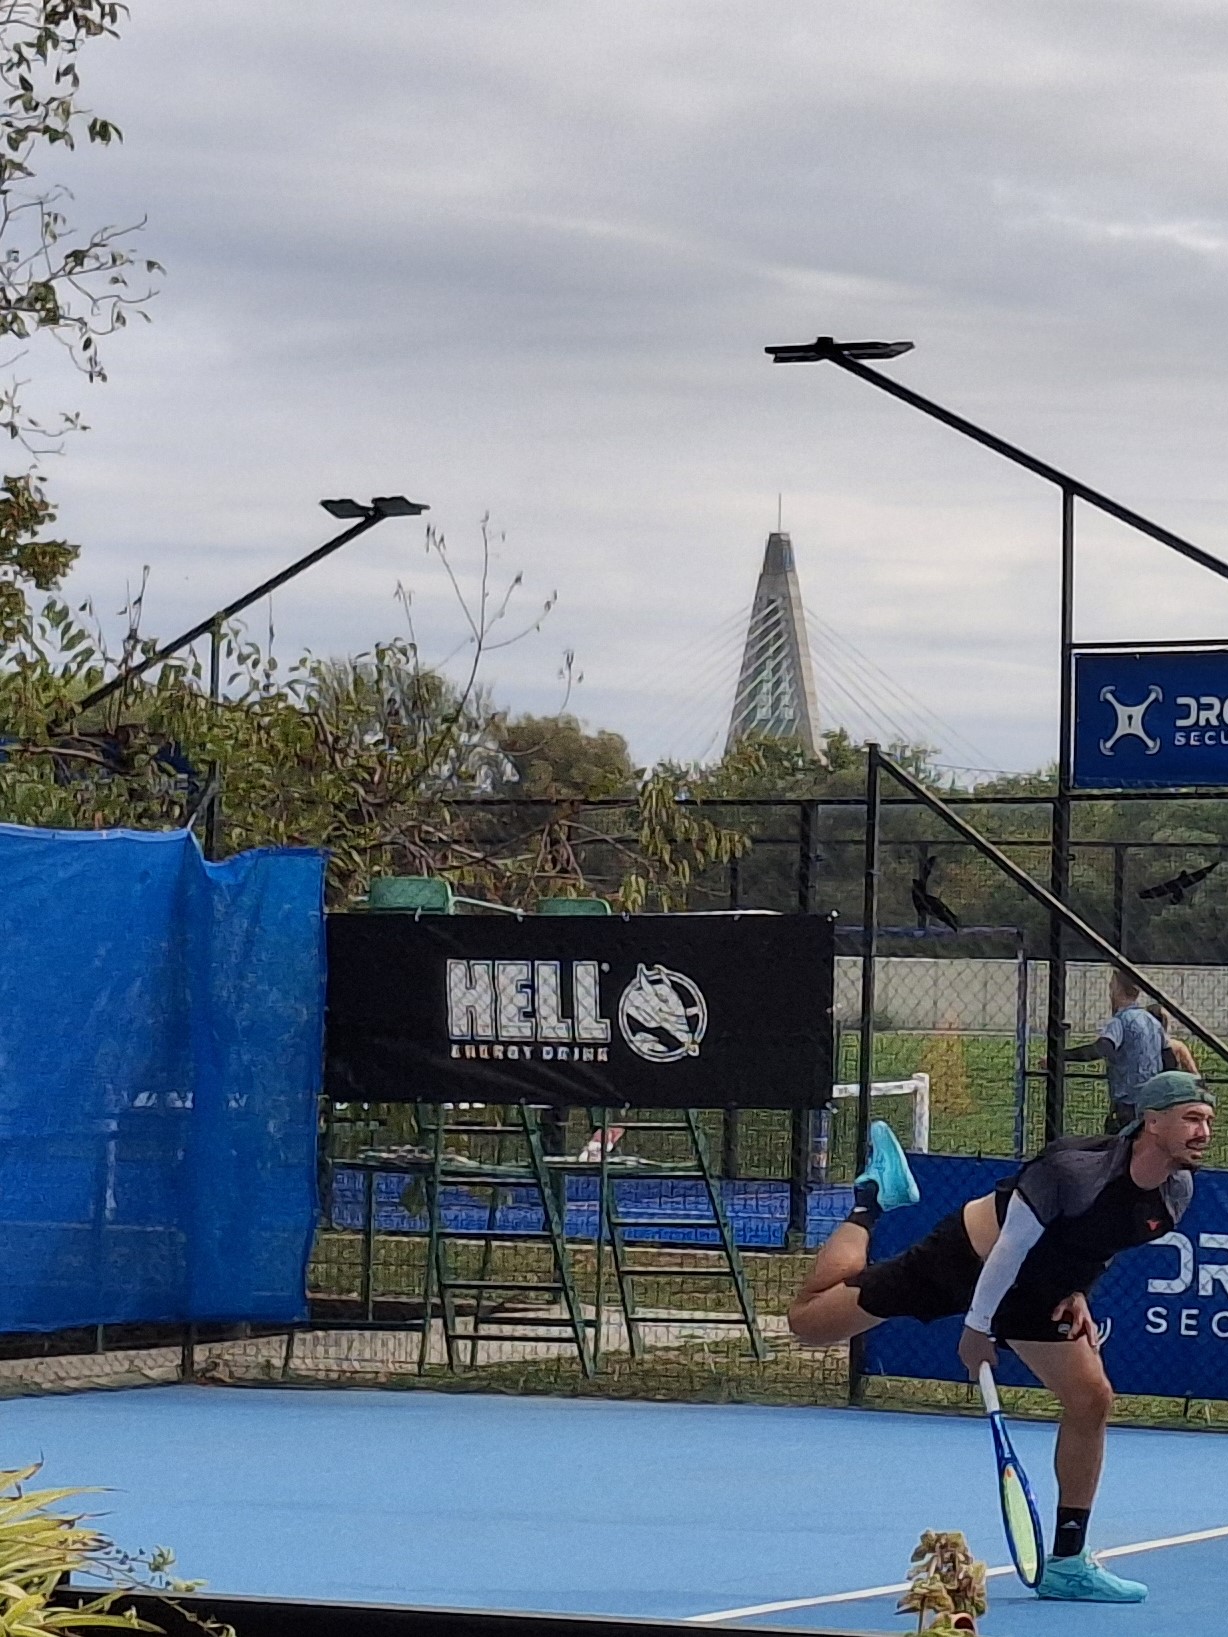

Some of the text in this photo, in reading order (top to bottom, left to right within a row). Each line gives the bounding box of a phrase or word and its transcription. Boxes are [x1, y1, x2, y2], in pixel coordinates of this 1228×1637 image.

[446, 959, 612, 1043] HELL
[451, 1044, 609, 1062] ENERGY DRINK
